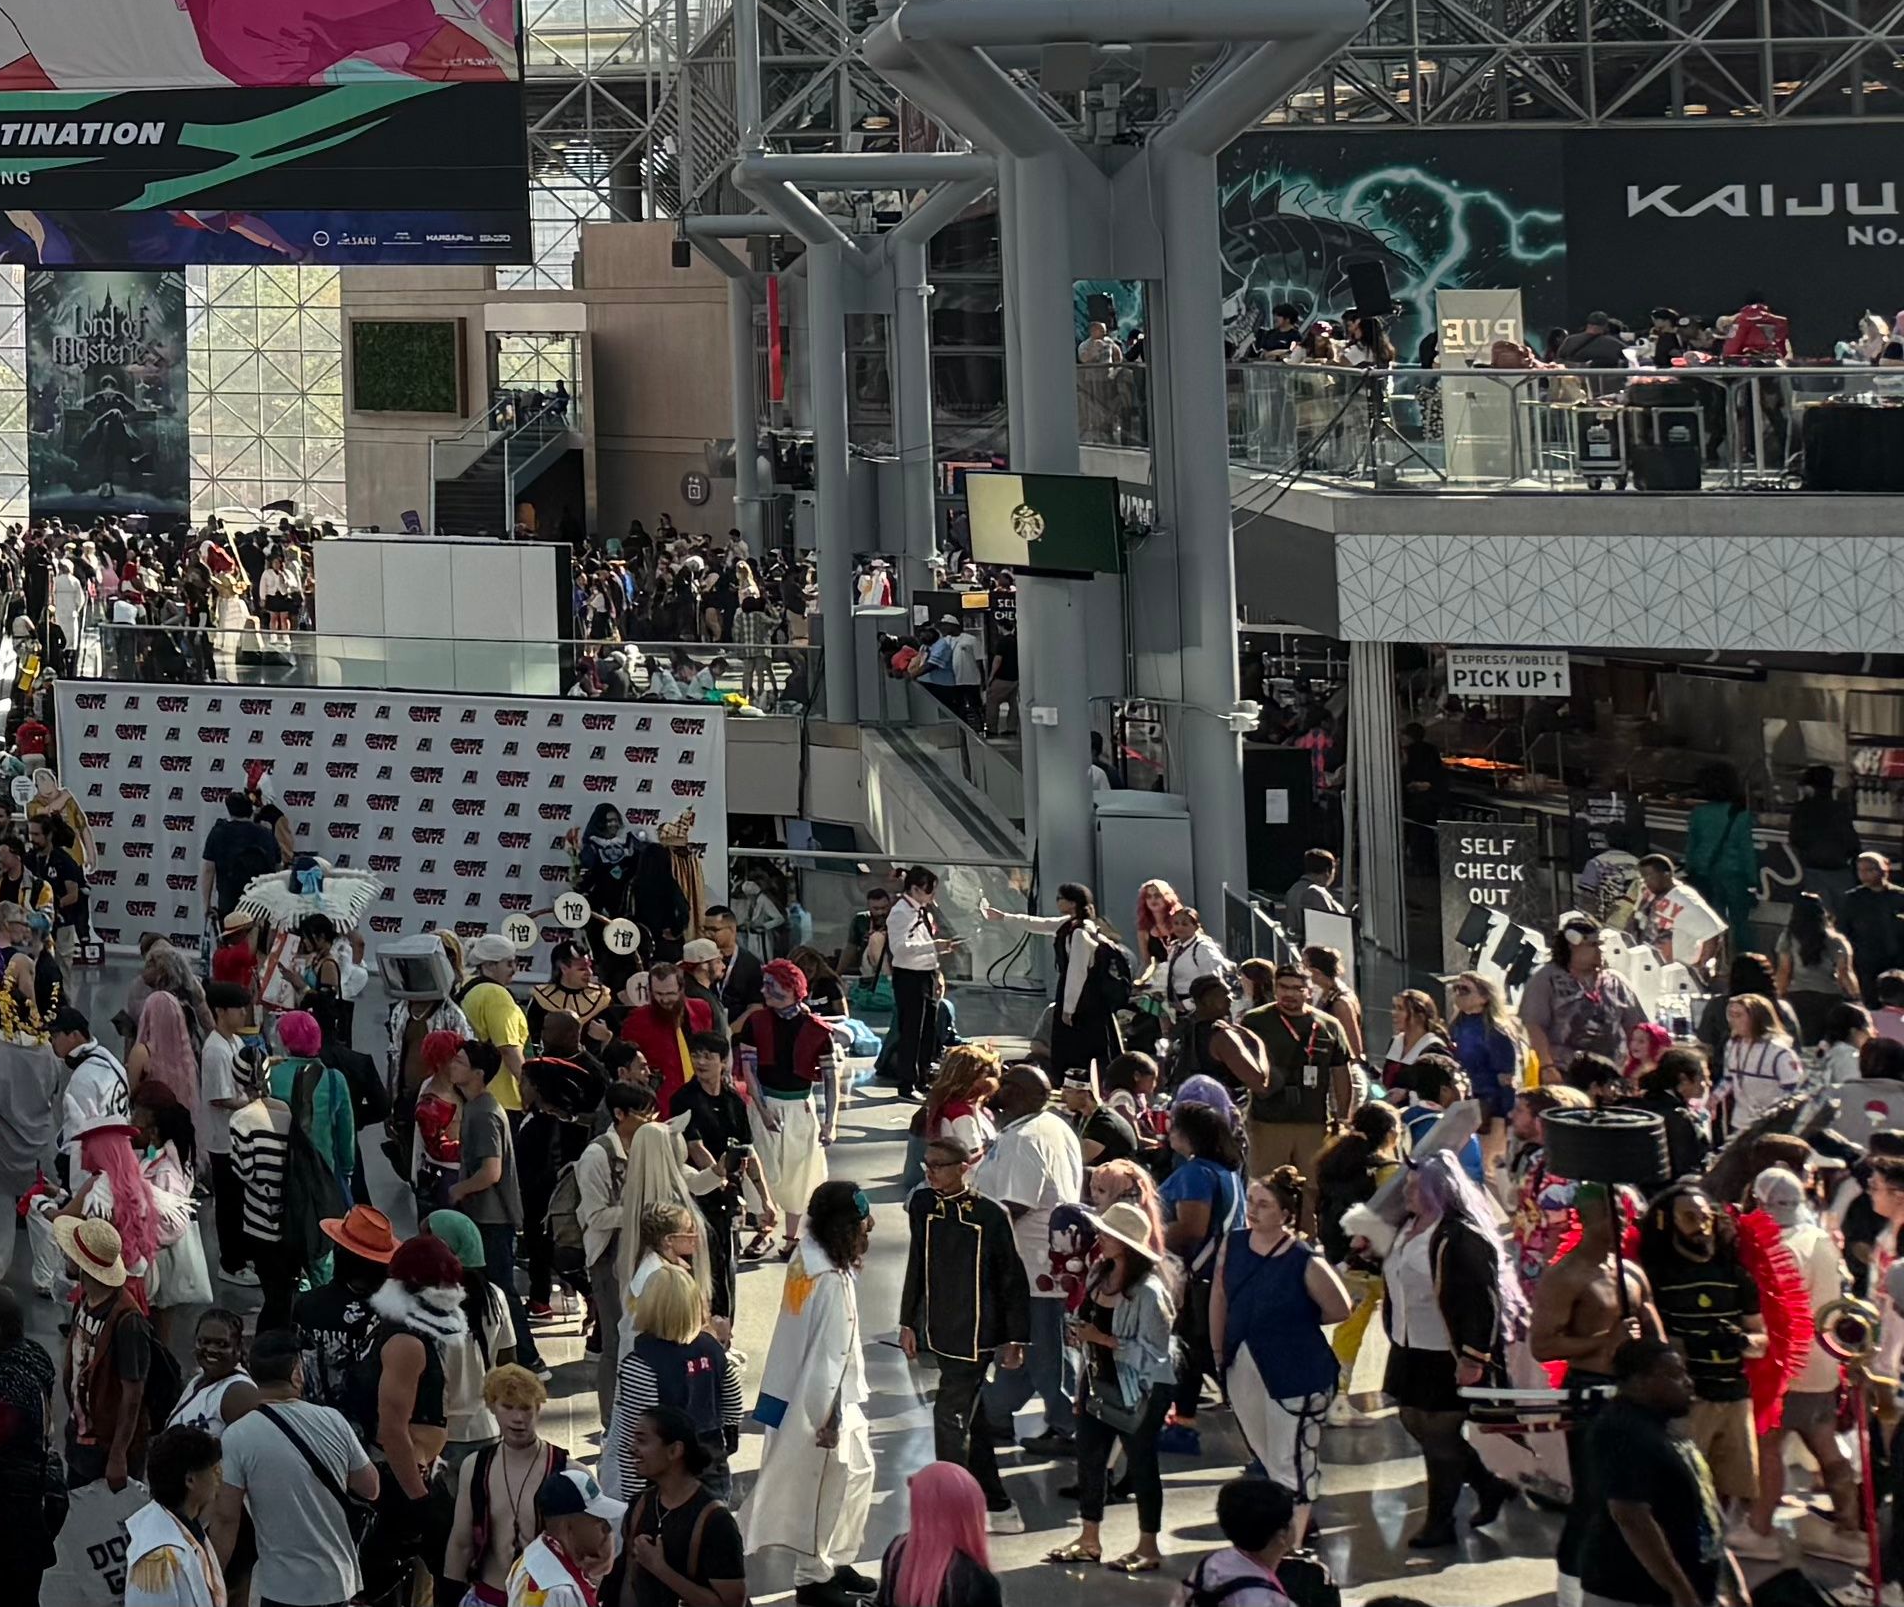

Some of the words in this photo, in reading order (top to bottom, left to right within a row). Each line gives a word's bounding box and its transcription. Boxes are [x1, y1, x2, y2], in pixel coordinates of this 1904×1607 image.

[1627, 182, 1899, 217] KAIJU
[72, 303, 116, 339] Lord
[121, 306, 149, 339] of
[52, 336, 165, 371] Mysteries
[998, 599, 1016, 608] SEL
[995, 611, 1016, 619] CHE
[1452, 655, 1563, 666] EXPRESS/MOBILE
[1454, 669, 1510, 687] PICK
[1517, 671, 1546, 688] UP
[1460, 838, 1516, 855] SELF
[1454, 862, 1524, 881] CHECK
[1469, 887, 1511, 905] OUT
